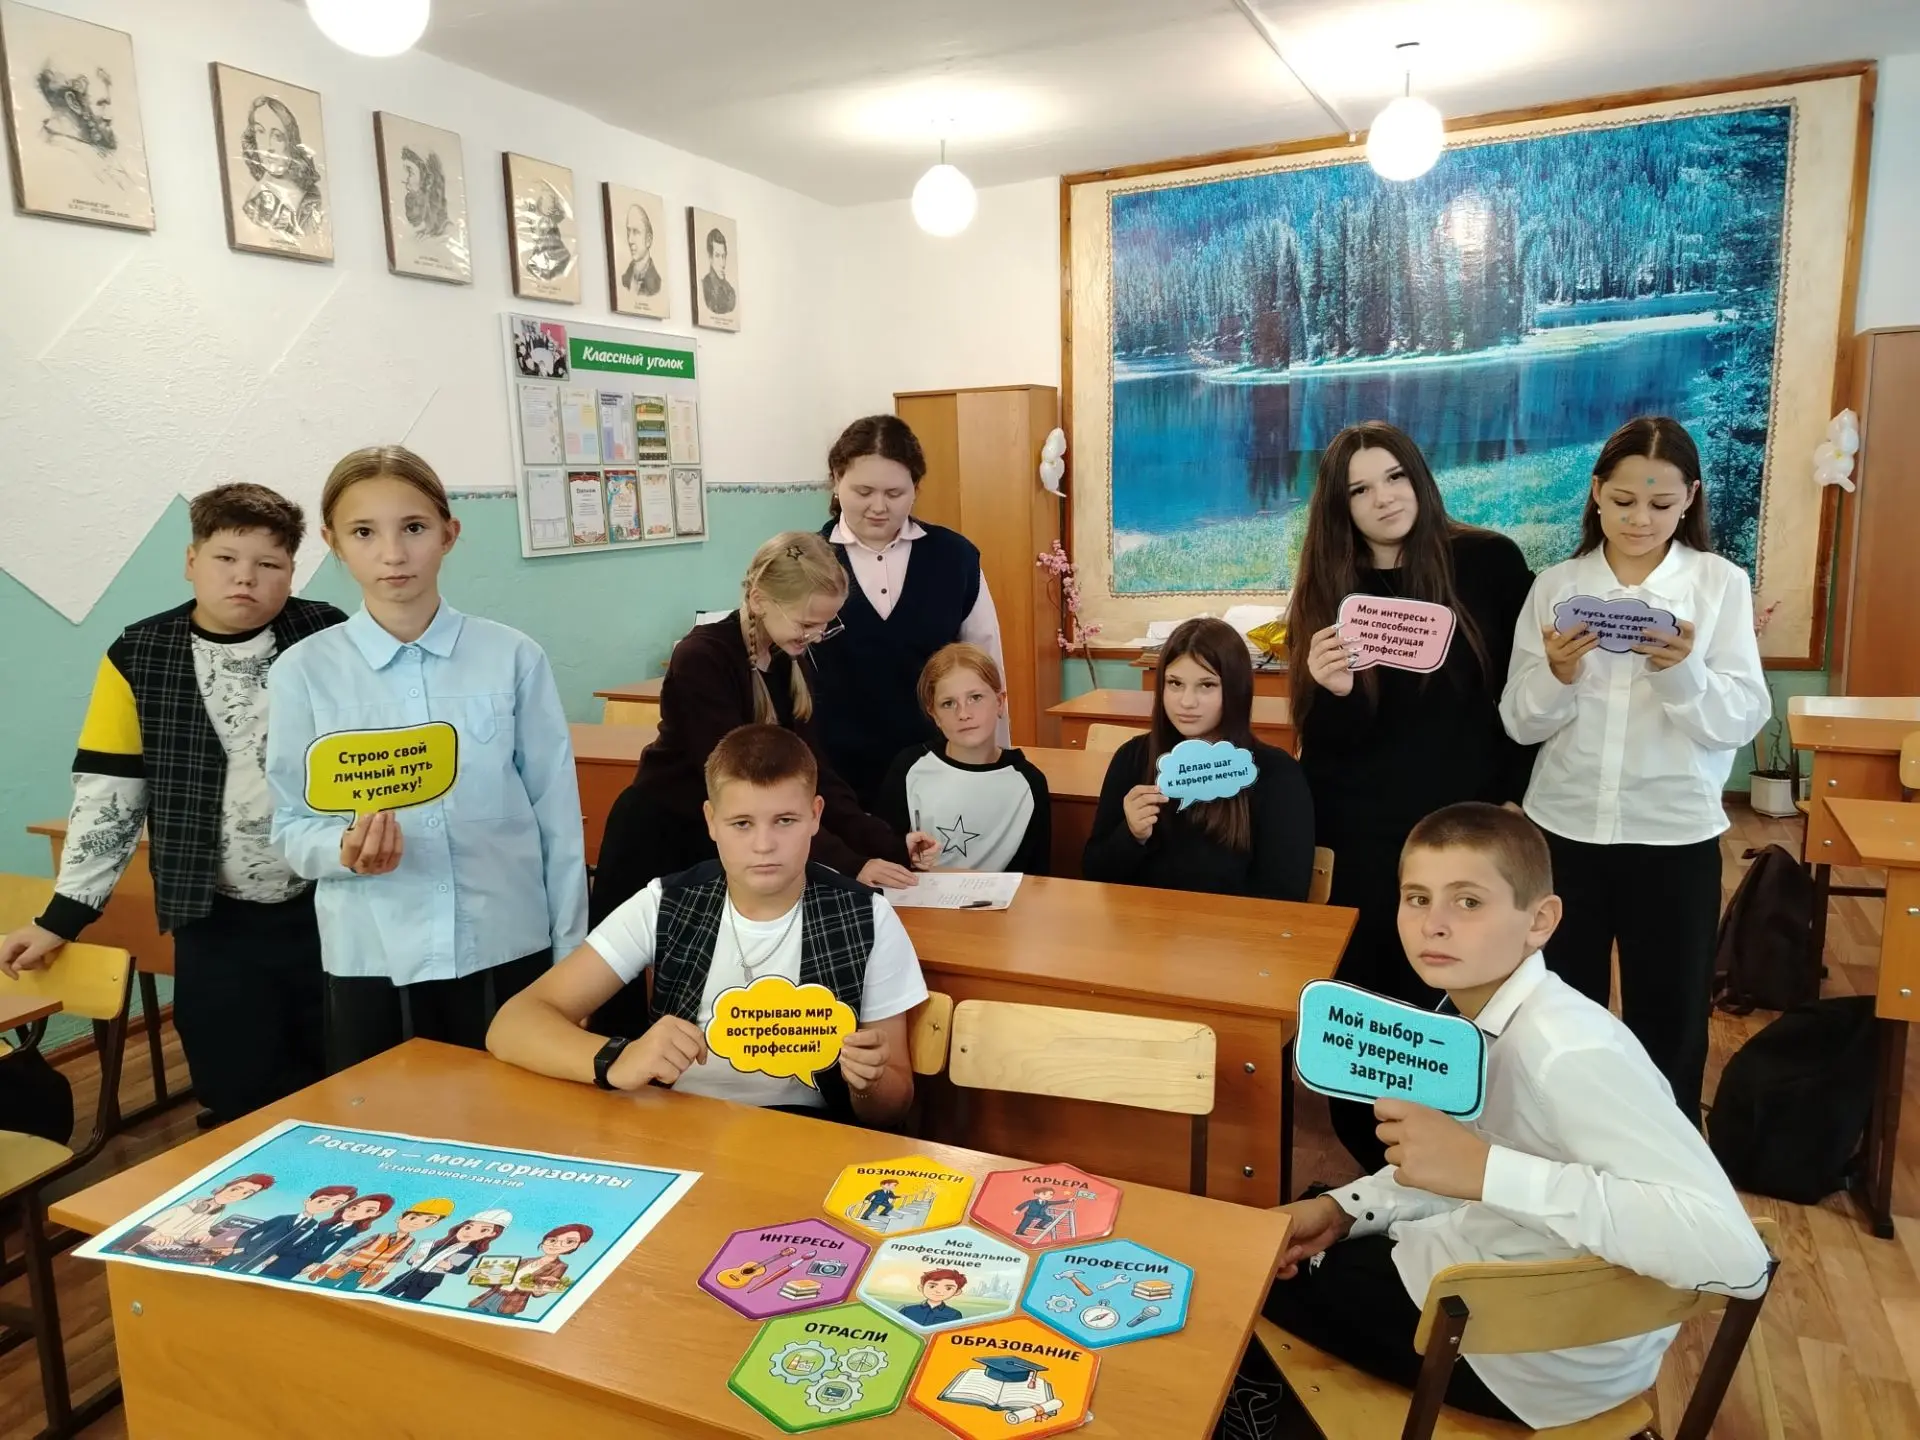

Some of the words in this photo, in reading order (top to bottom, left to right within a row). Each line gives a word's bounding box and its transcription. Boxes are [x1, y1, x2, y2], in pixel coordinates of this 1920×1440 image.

[582, 346, 644, 366] Классный
[646, 356, 684, 371] уголок
[1357, 604, 1378, 615] Мои
[1381, 608, 1428, 623] интересы
[1572, 608, 1606, 619] Учусь
[1608, 613, 1658, 624] сегодня,
[1350, 617, 1369, 627] мои
[1371, 620, 1429, 636] способности
[1619, 624, 1648, 632] стат
[1359, 630, 1379, 640] моя
[1381, 633, 1424, 648] будущая
[1362, 643, 1418, 659] профессия!
[338, 751, 389, 766] Строю
[393, 742, 427, 758] свой
[333, 764, 395, 783] личный
[400, 760, 433, 776] путь
[1175, 773, 1213, 787] карьере
[1215, 766, 1249, 780] мечты!
[1178, 762, 1211, 775] Делаю
[1213, 759, 1232, 768] шаг
[352, 789, 361, 799] к
[366, 776, 422, 800] успеху!
[730, 1006, 802, 1021] Открываю
[805, 1007, 833, 1020] мир
[726, 1023, 838, 1039] востребованных
[1328, 1005, 1364, 1029] Мой
[1369, 1018, 1424, 1047] выбор
[743, 1040, 821, 1057] профессий!
[1322, 1030, 1355, 1050] моё
[1358, 1040, 1449, 1075] уверенное
[1350, 1061, 1414, 1091] завтра!
[307, 1134, 399, 1159] Россия
[424, 1152, 484, 1170] мои
[484, 1160, 633, 1189] горизонты
[377, 1161, 470, 1181] Установочное
[469, 1174, 526, 1189] занятие
[856, 1167, 965, 1184] ВОЗМОЖНОСТИ
[1022, 1175, 1090, 1190] КАРЬЕРА
[759, 1232, 845, 1250] ИНТЕРЕСЫ
[944, 1239, 973, 1249] Моё
[890, 1242, 1022, 1264] профессиональное
[921, 1254, 982, 1268] будущее
[1063, 1254, 1170, 1274] ПРОФЕССИИ
[804, 1322, 889, 1344] ОТРАСЛИ
[950, 1334, 1084, 1362] ОБРАЗОВАНИЕ
